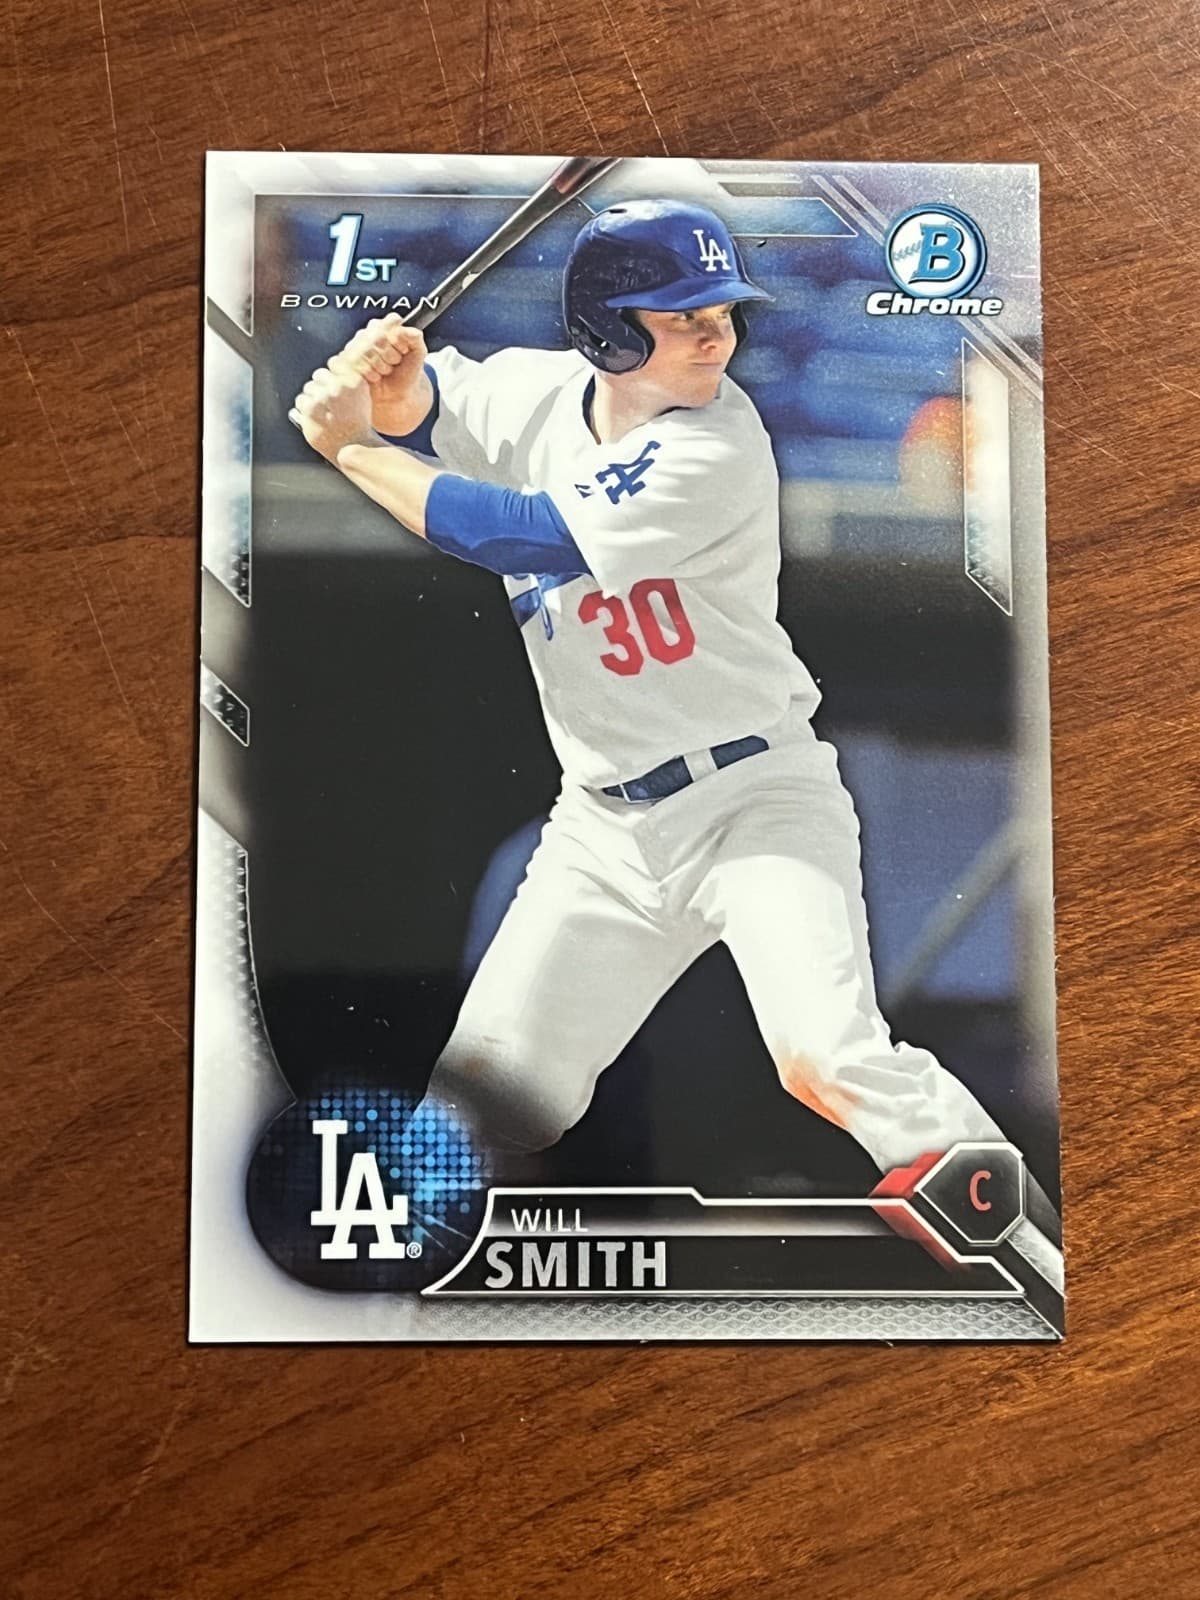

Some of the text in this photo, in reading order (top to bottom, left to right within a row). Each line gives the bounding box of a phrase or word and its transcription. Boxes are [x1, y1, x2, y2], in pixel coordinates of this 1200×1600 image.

[327, 213, 397, 286] 1ST
[692, 229, 731, 272] LA
[908, 222, 965, 285] B
[280, 294, 439, 309] BOWMAN
[866, 291, 1003, 316] Chrome
[577, 578, 696, 676] 30
[969, 1170, 992, 1211] C
[511, 1208, 589, 1233] WILL
[484, 1240, 667, 1289] SMITH
